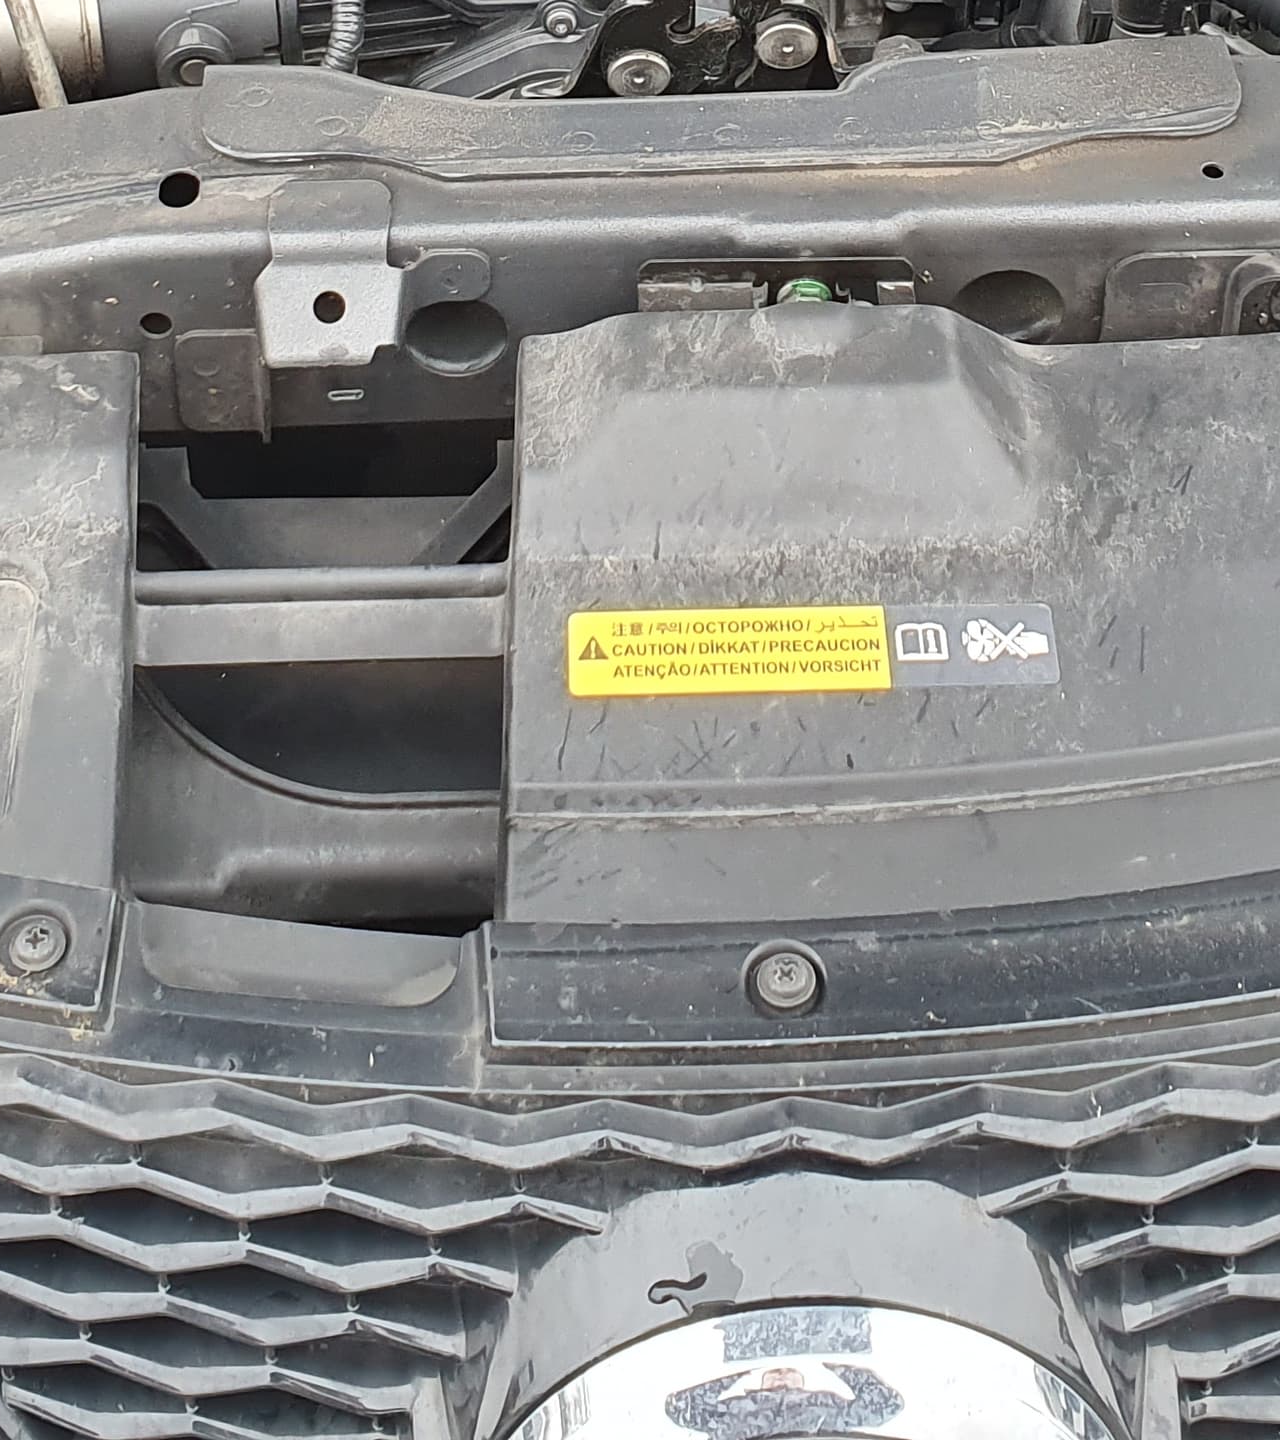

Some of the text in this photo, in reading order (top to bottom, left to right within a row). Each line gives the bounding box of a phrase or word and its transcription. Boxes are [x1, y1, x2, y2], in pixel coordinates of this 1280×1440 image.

[612, 642, 687, 656] CAUTION
[769, 638, 880, 652] PRECAUCION
[613, 661, 691, 680] ATENÇÃO
[700, 661, 789, 676] ATTENTION
[799, 659, 881, 674] VORSICHT
